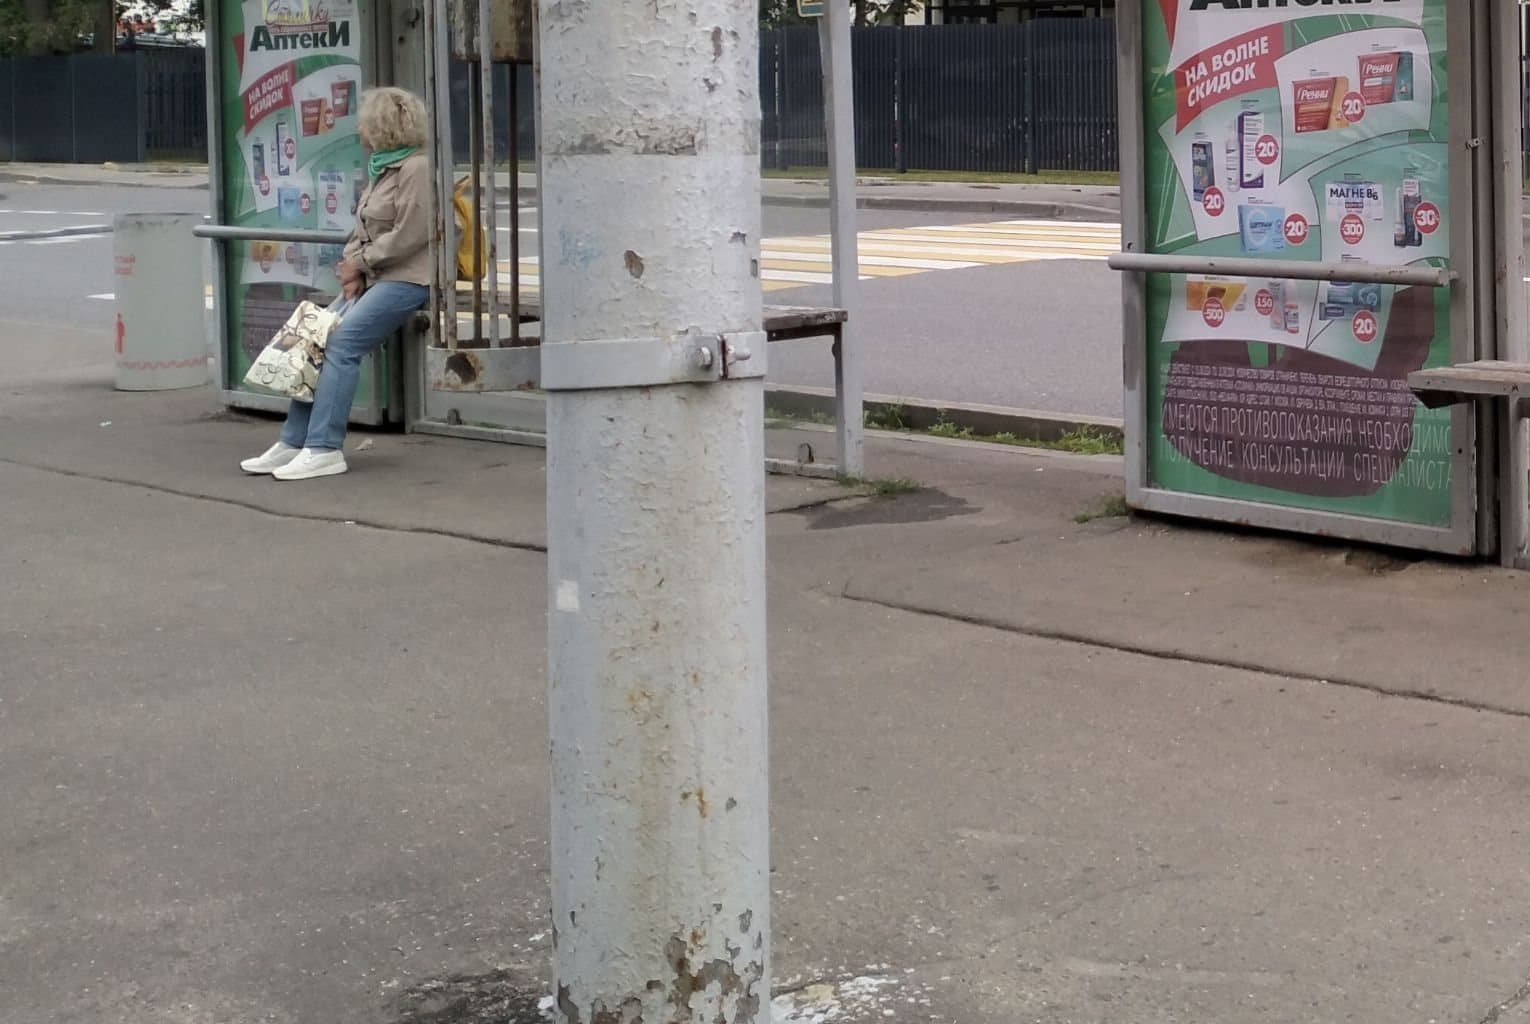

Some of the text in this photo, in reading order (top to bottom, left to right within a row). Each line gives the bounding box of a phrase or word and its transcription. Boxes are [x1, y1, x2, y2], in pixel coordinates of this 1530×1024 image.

[1185, 36, 1269, 88] НА ВОЛНЕ
[1187, 62, 1256, 107] СКИДОК
[1330, 188, 1365, 199] МАГНЕ
[1160, 402, 1218, 433] ИМЕЮТСЯ
[1160, 434, 1234, 469] ПОЛУЧЕНИЕ
[1242, 441, 1345, 481] КОНСУЛЬТАЦИИ
